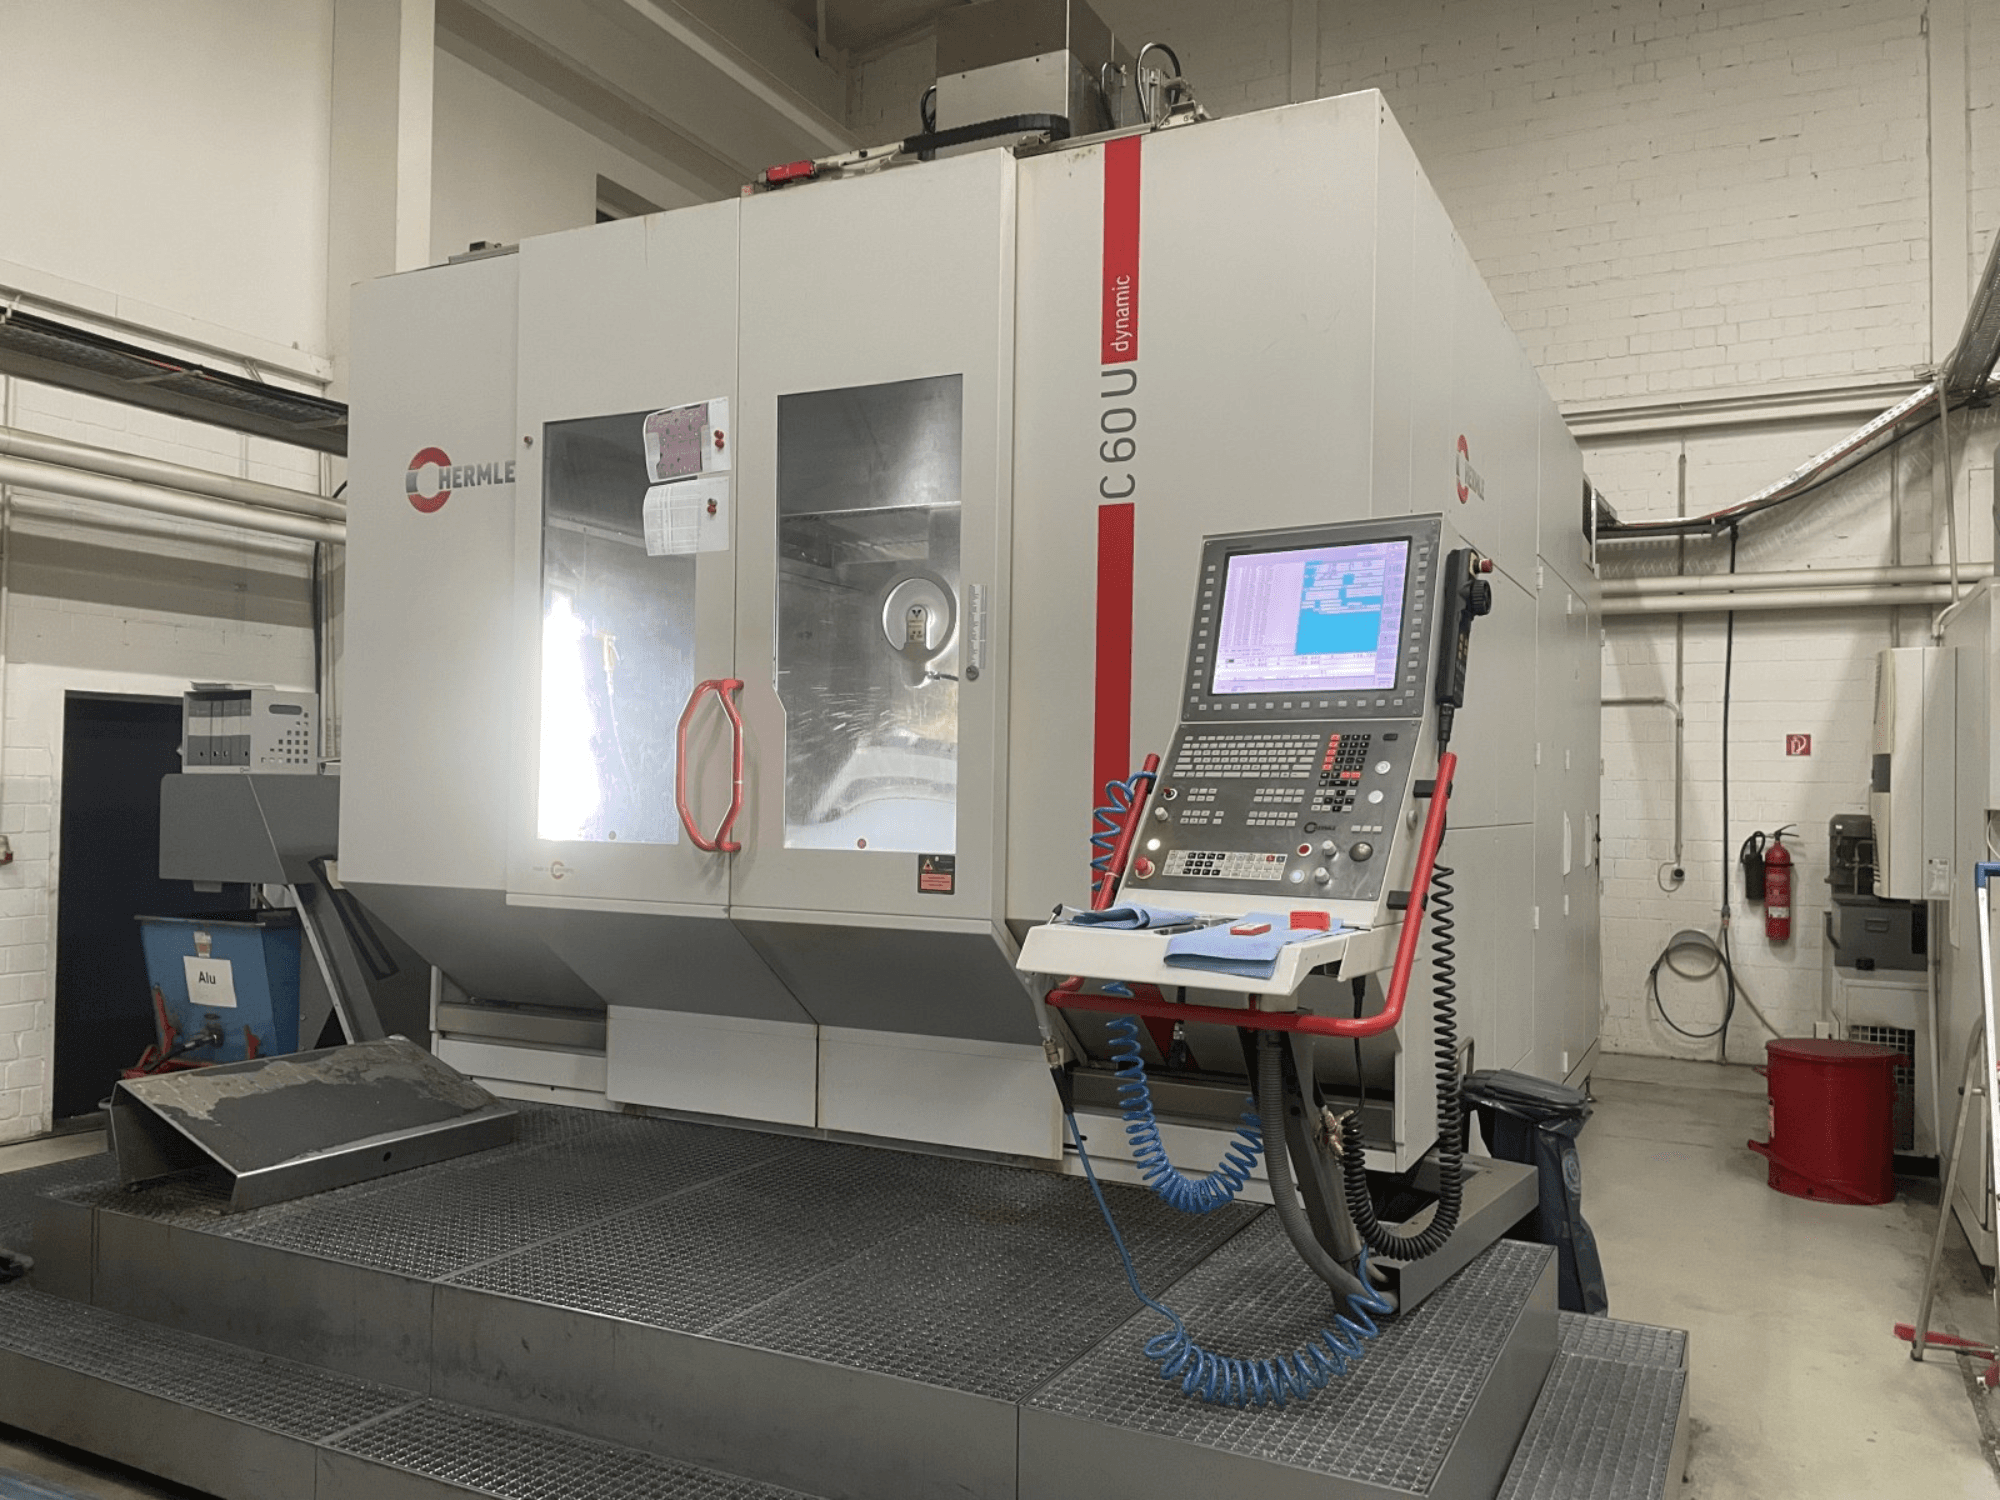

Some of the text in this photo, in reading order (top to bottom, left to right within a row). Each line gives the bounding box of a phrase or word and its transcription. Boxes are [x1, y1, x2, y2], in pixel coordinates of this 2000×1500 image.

[1110, 274, 1132, 352] dynamic
[438, 460, 516, 490] HERMLE
[198, 971, 216, 985] Alu
